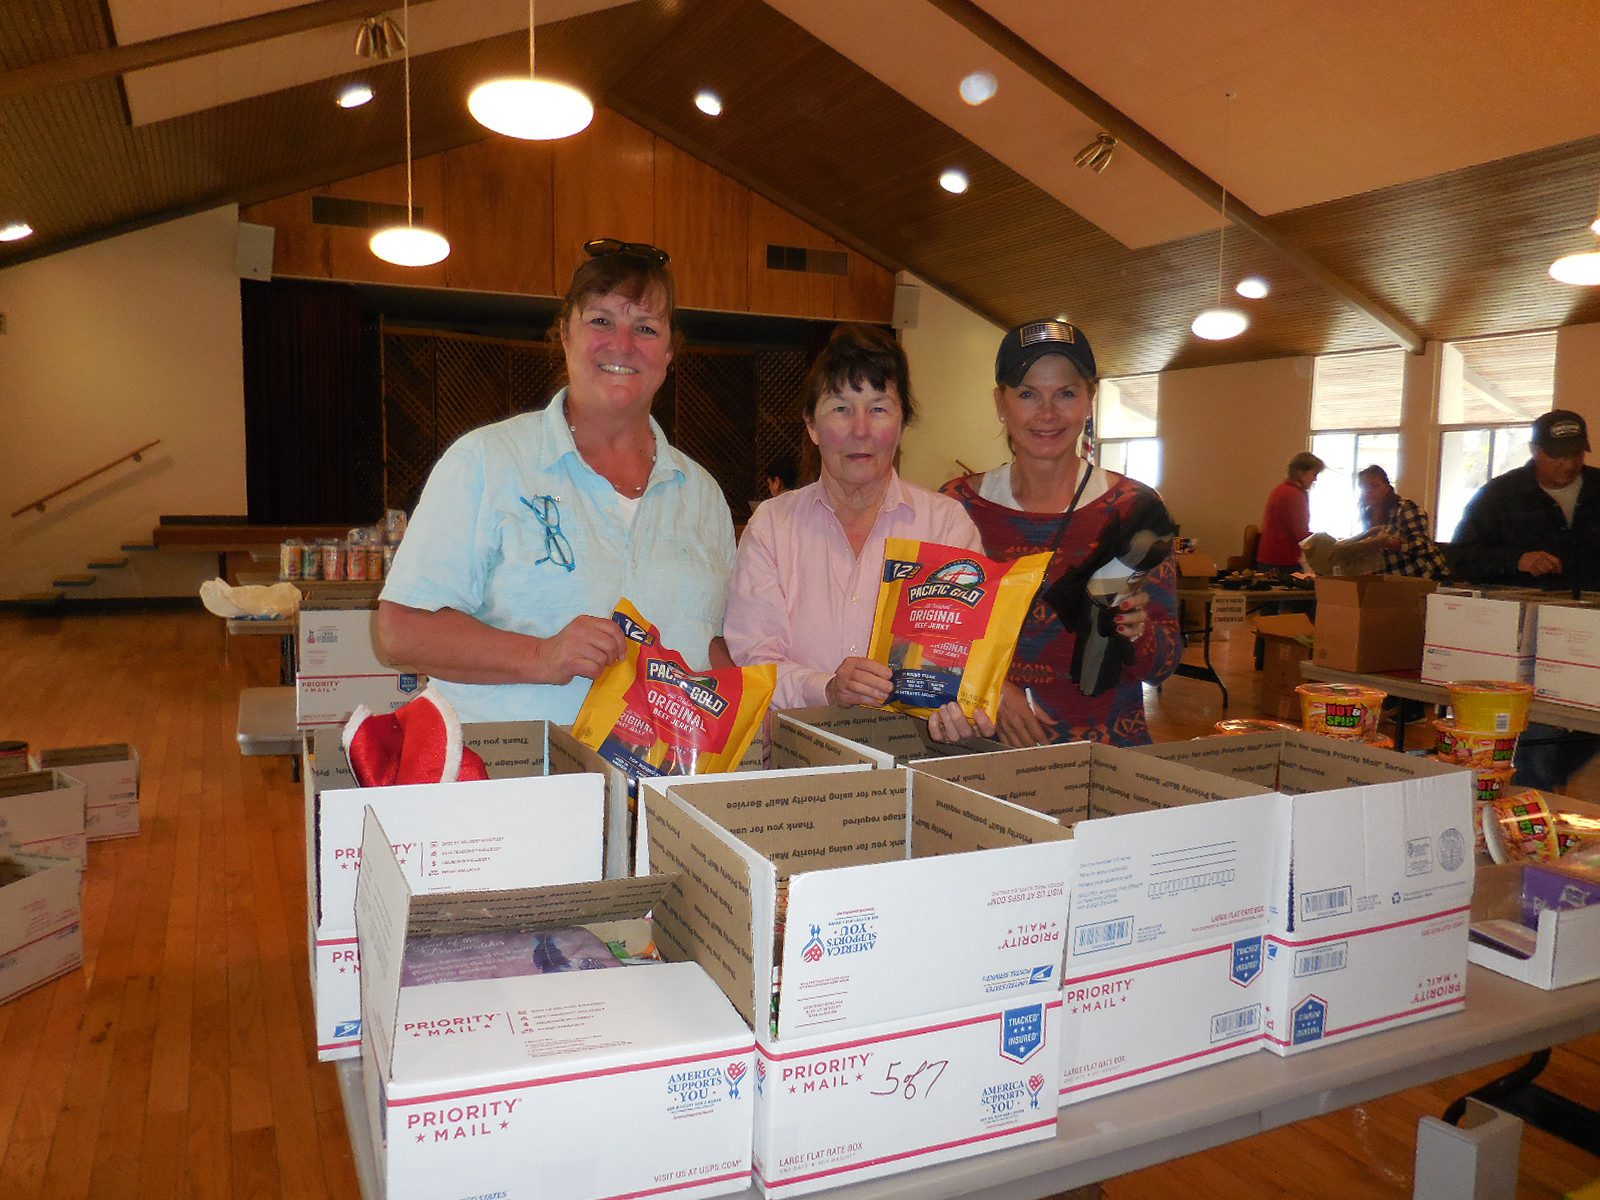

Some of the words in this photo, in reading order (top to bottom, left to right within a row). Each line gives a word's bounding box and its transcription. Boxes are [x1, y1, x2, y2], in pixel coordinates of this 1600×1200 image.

[910, 584, 950, 600] PACIFIC
[910, 610, 962, 625] ORIGINAL
[928, 622, 950, 630] JERKY
[690, 686, 723, 713] GOLD
[647, 689, 707, 733] ORIGINAL
[1327, 704, 1353, 716] HOT
[1352, 708, 1361, 716] &
[620, 713, 655, 735] RIGINAL
[653, 707, 670, 721] BEEF
[670, 718, 694, 733] JERKY
[852, 716, 877, 725] Priority
[467, 738, 481, 747] for
[483, 738, 499, 746] you
[502, 737, 529, 745] Thank
[495, 758, 530, 768] postage
[1016, 764, 1047, 776] required
[1048, 760, 1076, 771] postage
[1333, 750, 1361, 764] Priority
[1384, 762, 1415, 776] Service
[963, 773, 986, 782] Thank
[1135, 771, 1161, 785] Service
[829, 790, 853, 802] using
[856, 789, 869, 799] for
[872, 788, 888, 798] you
[889, 786, 907, 796] ank
[1009, 789, 1036, 800] Priority
[1181, 784, 1210, 800] Priority
[726, 800, 762, 810] Service
[791, 793, 827, 805] Priority
[936, 799, 960, 815] required
[843, 814, 881, 827] required
[883, 812, 907, 823] stage
[962, 809, 987, 825] postage
[750, 823, 764, 833] for
[767, 822, 784, 832] you
[786, 820, 815, 831] Thank
[931, 822, 953, 840] Priority
[889, 838, 907, 848] ank
[1008, 827, 1033, 844] Priority
[335, 842, 413, 860] PRITY
[791, 846, 827, 859] Priority
[829, 843, 853, 855] using
[856, 841, 869, 851] for
[871, 840, 888, 850] you
[719, 865, 738, 886] Priority
[1027, 891, 1036, 900] AT
[1037, 890, 1046, 899] US
[1047, 888, 1064, 897] VISIT
[719, 896, 734, 916] Thank
[840, 923, 867, 936] YOU
[1017, 921, 1047, 933] MAIL
[723, 931, 741, 955] Priority
[826, 931, 877, 947] SUPPORTS
[1001, 931, 1060, 949] PRIORITY
[827, 940, 876, 957] AMERICA
[721, 959, 737, 981] Thank
[1067, 979, 1132, 1003] PRIORITY
[1413, 981, 1461, 1003] PRIORITY
[1083, 998, 1117, 1013] MAIL
[404, 1013, 497, 1032] PRIORITY
[1008, 1013, 1038, 1027] TRACKED
[428, 1025, 477, 1038] MAIL
[1008, 1033, 1037, 1046] INSURED
[782, 1053, 871, 1082] PRIORITY
[668, 1067, 722, 1084] AMERICA
[870, 1060, 949, 1100] 587
[667, 1077, 722, 1094] SUPPORTS
[803, 1078, 848, 1094] MAIL
[982, 1080, 1026, 1097] AMERICA
[680, 1088, 709, 1103] YOU
[981, 1089, 1025, 1106] SUPPORTS
[408, 1098, 518, 1129] PRIORITY
[991, 1099, 1014, 1114] YOU
[434, 1122, 491, 1143] MAIL
[779, 1154, 804, 1167] LARGE
[806, 1149, 825, 1161] FLAT
[826, 1145, 846, 1157] RATE
[848, 1142, 864, 1152] BOX
[654, 1172, 674, 1182] VISIT
[675, 1169, 686, 1178] US
[687, 1167, 698, 1176] AT
